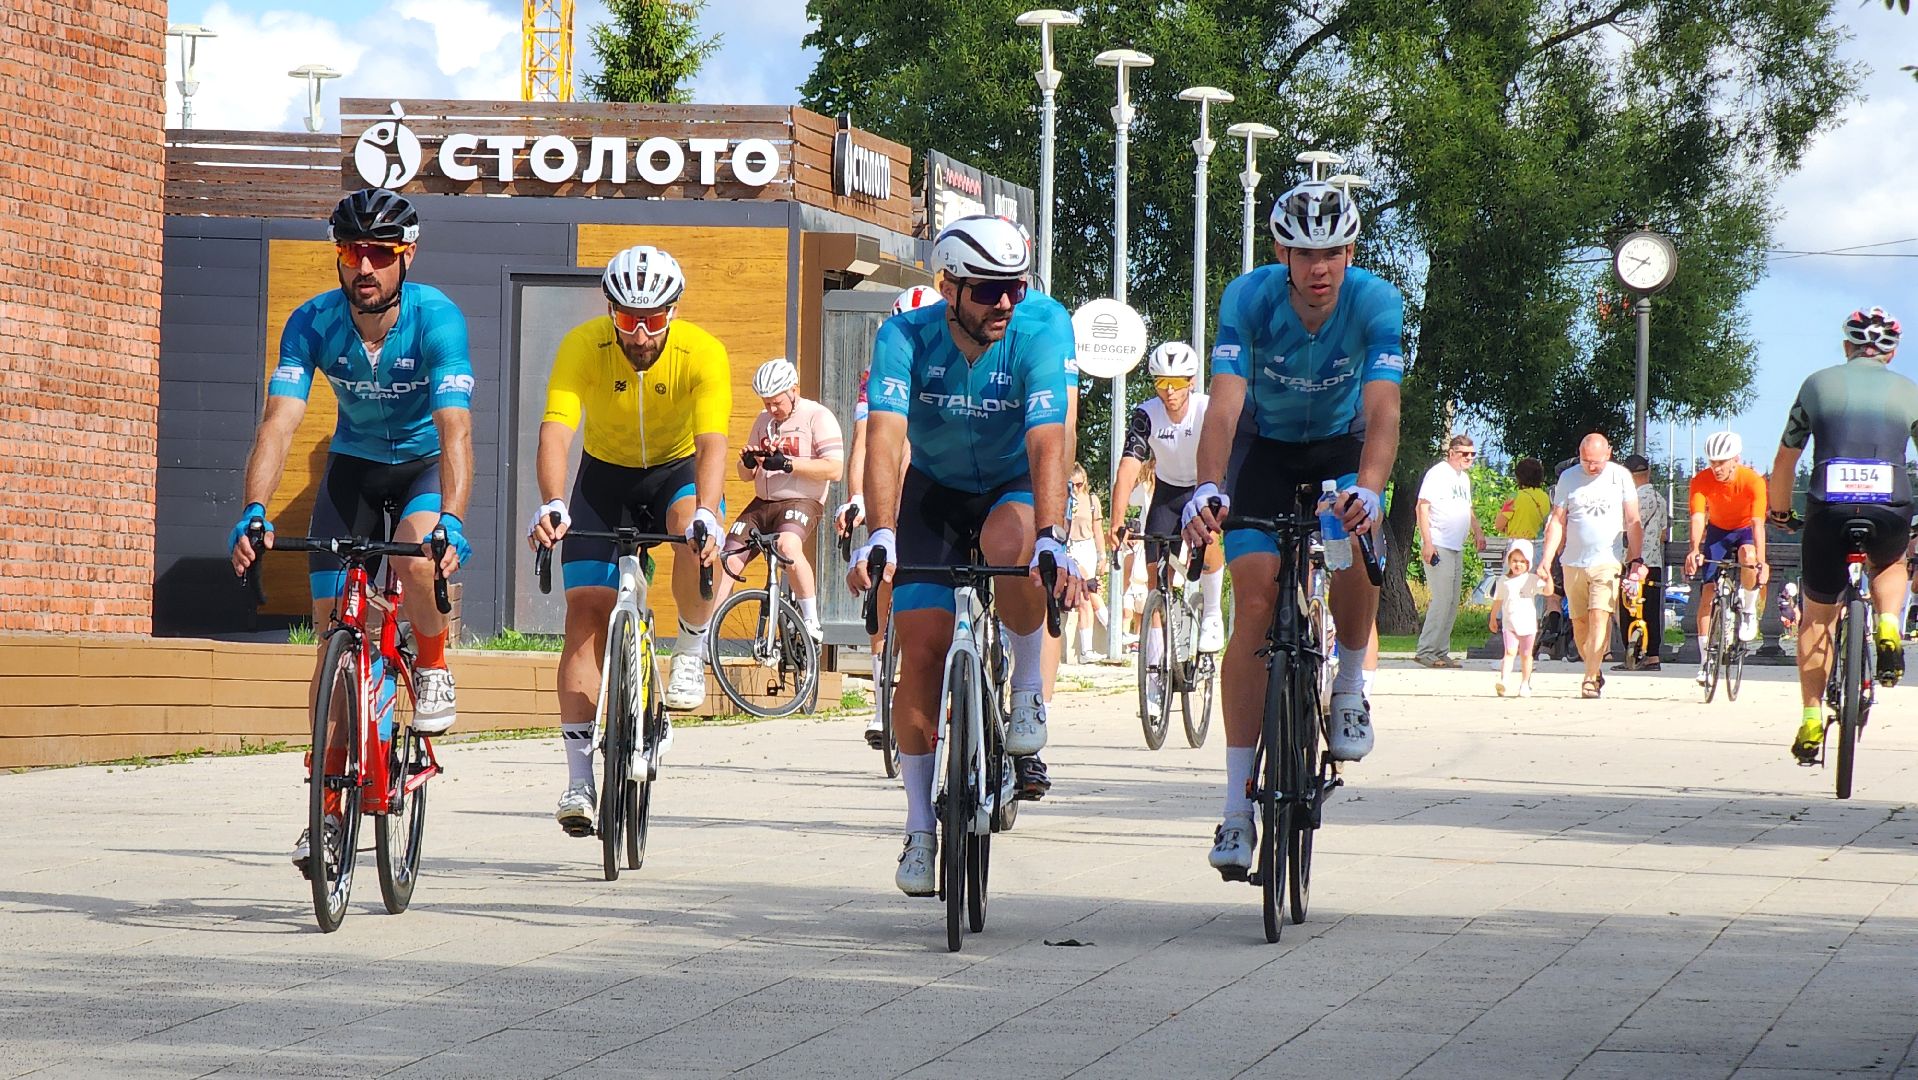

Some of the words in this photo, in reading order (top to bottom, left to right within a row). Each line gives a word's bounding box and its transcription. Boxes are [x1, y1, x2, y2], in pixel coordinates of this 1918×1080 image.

[438, 133, 780, 187] СТОЛОТО
[853, 144, 891, 200] СТОЛОТО
[630, 295, 650, 305] 250
[1075, 343, 1091, 352] HE
[359, 392, 400, 400] TEAM
[919, 392, 1021, 412] ETALON
[950, 408, 989, 420] TEAM
[1839, 468, 1879, 482] 1154
[785, 509, 809, 527] SYN
